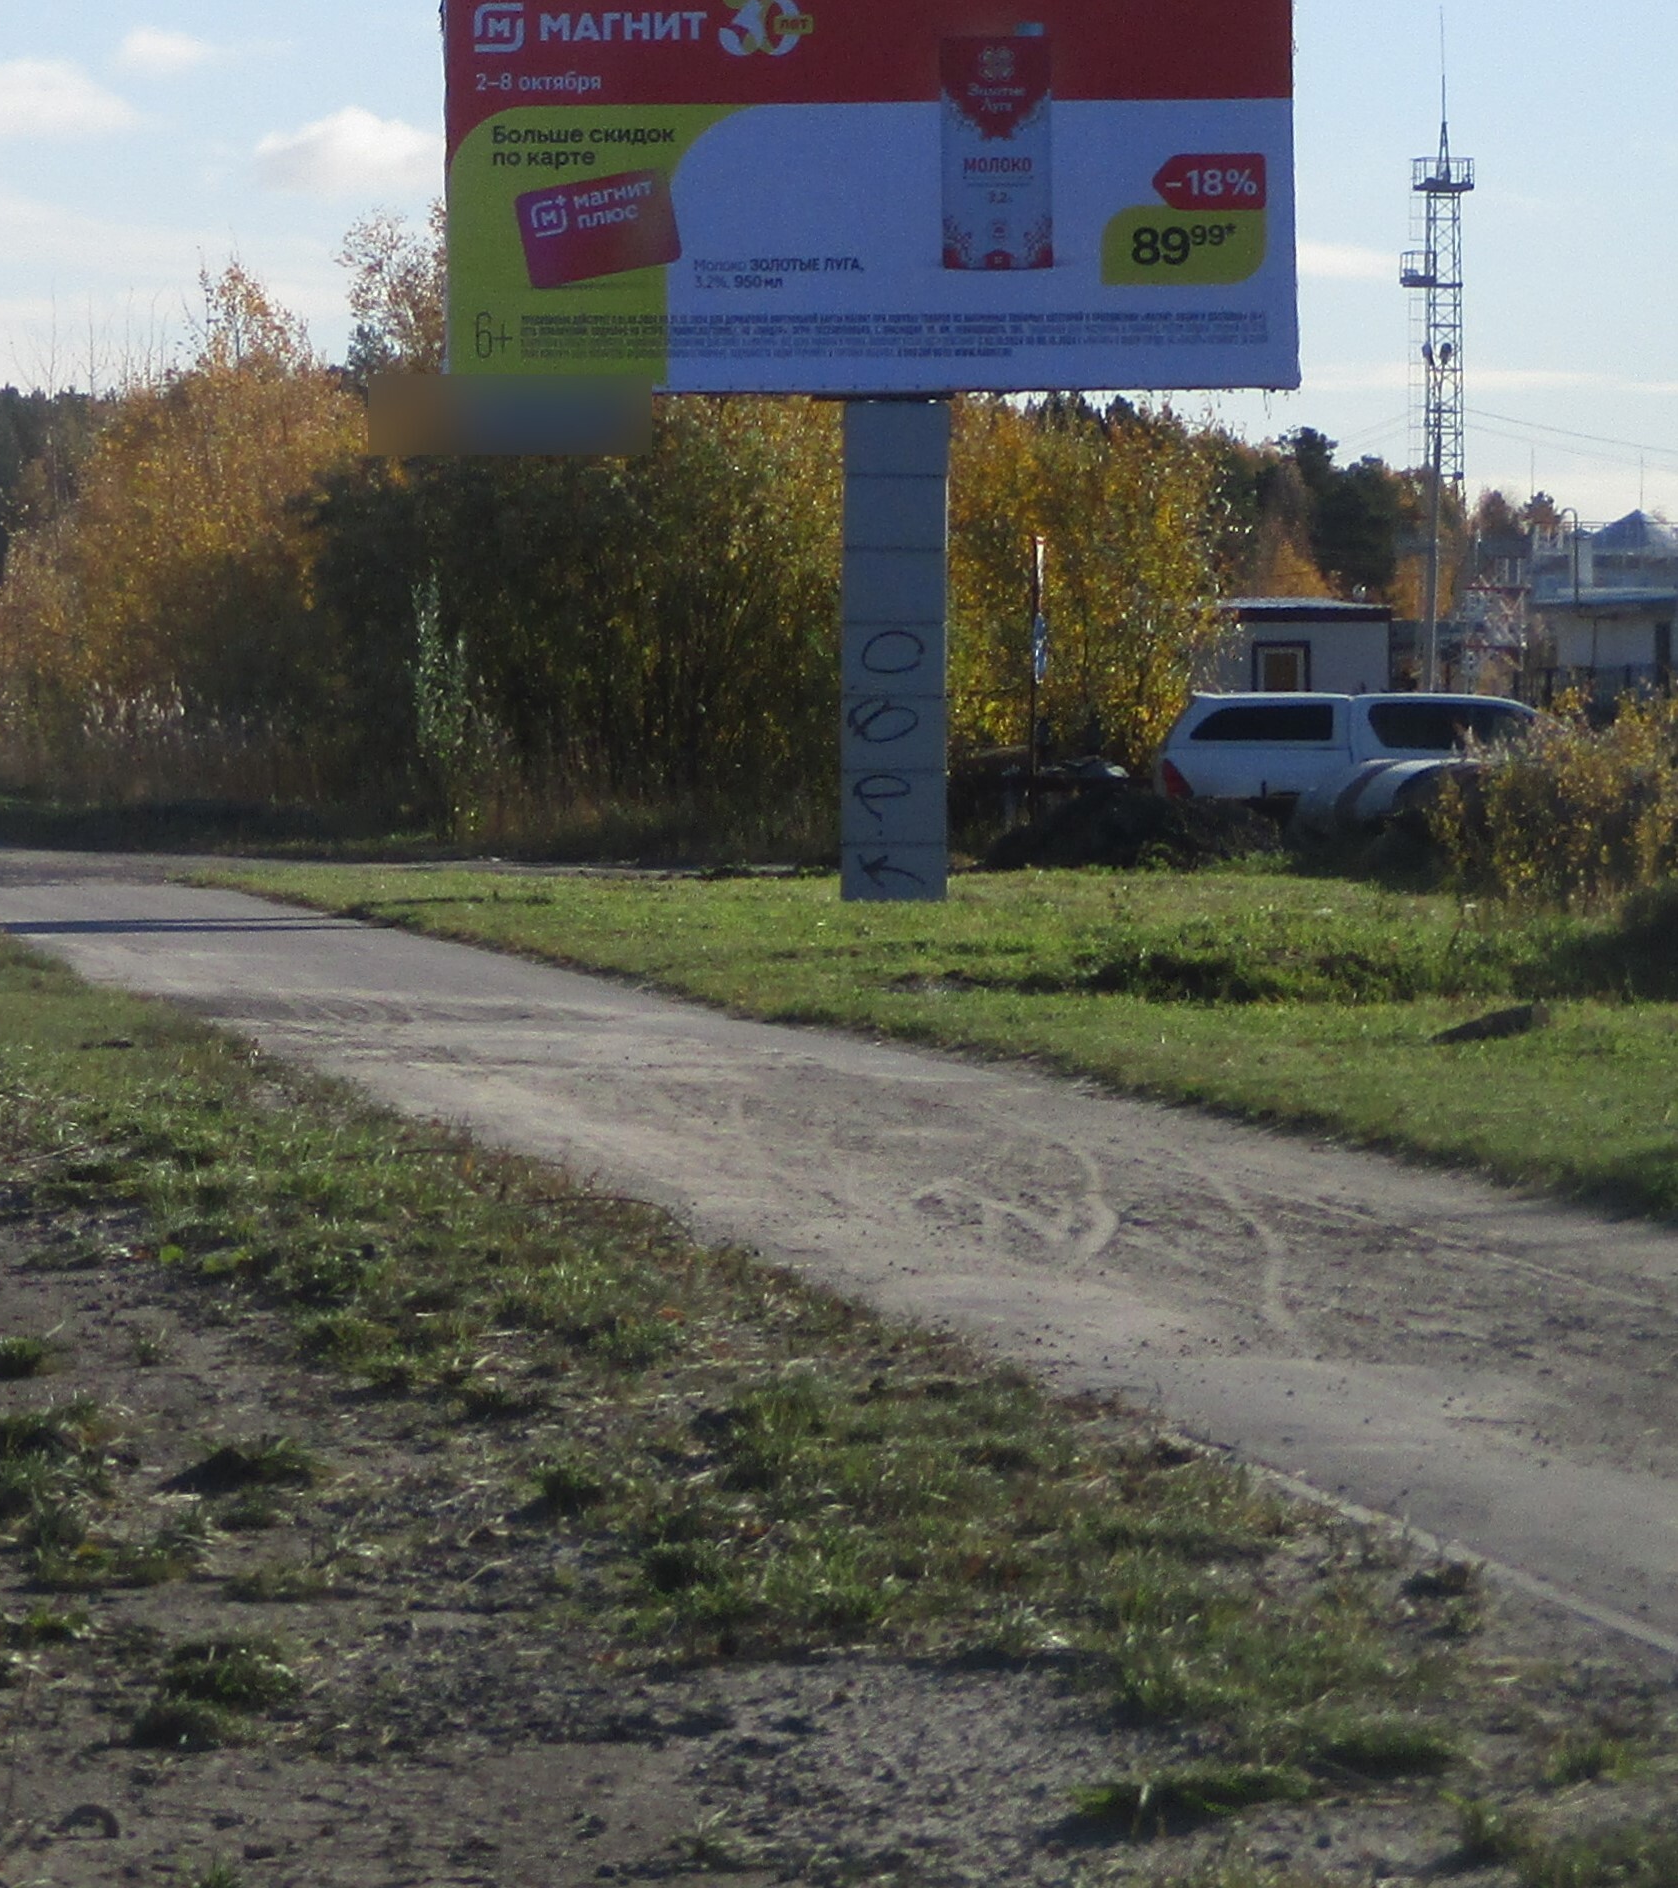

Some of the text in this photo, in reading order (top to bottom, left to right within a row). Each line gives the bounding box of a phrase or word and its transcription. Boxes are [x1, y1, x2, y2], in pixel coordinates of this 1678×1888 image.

[539, 11, 708, 42] МАГНИТ
[519, 71, 602, 93] октября
[493, 125, 675, 147] Больше скидок
[493, 150, 596, 170] по карте
[963, 157, 1032, 173] МОЛОКО
[573, 180, 652, 209] магнит
[577, 204, 640, 229] плюс
[694, 257, 865, 273] Молоко ЗОЛОТЫЕ ЛУГА,
[475, 312, 513, 359] 6+
